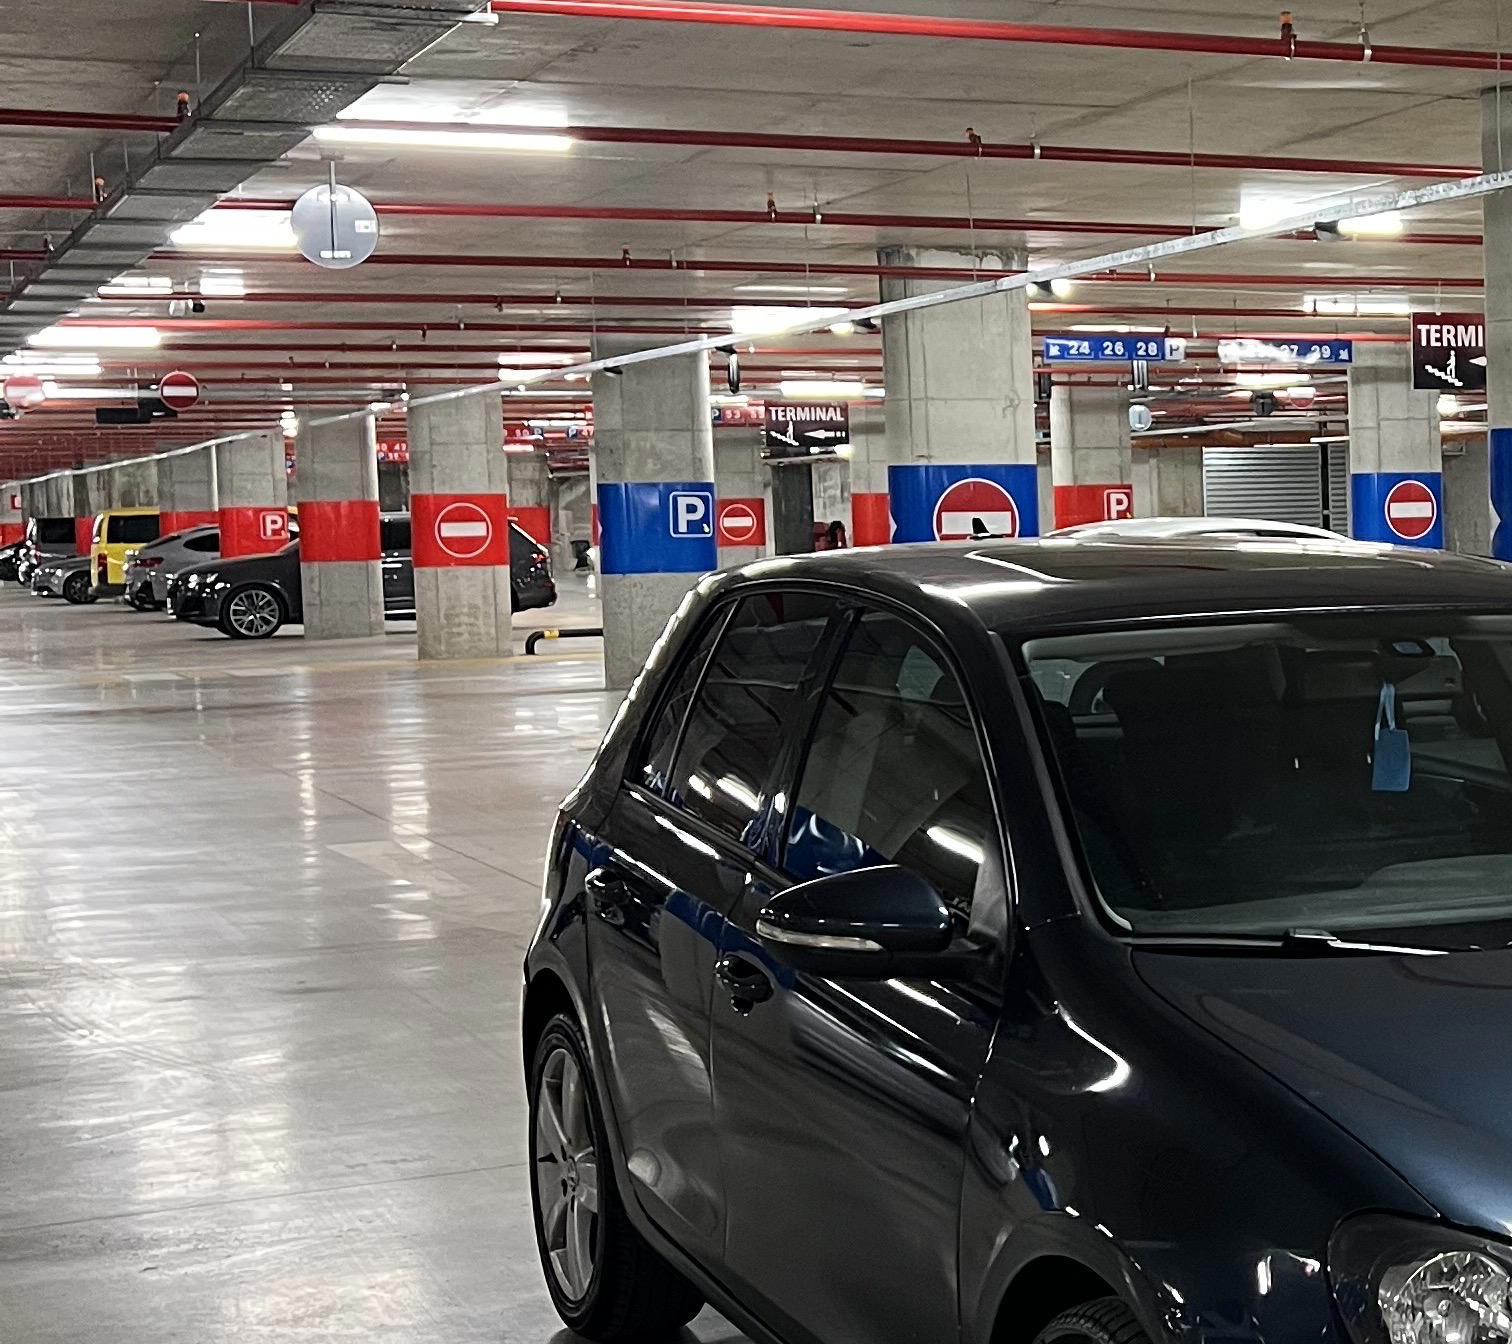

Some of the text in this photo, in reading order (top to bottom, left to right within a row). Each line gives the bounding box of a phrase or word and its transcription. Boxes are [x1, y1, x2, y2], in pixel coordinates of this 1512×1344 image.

[1069, 341, 1090, 355] 24
[1102, 341, 1124, 355] 26
[1136, 341, 1158, 355] 28
[768, 406, 845, 421] TERMINAL
[677, 496, 705, 533] P
[1110, 493, 1129, 520] P
[265, 515, 283, 537] P
